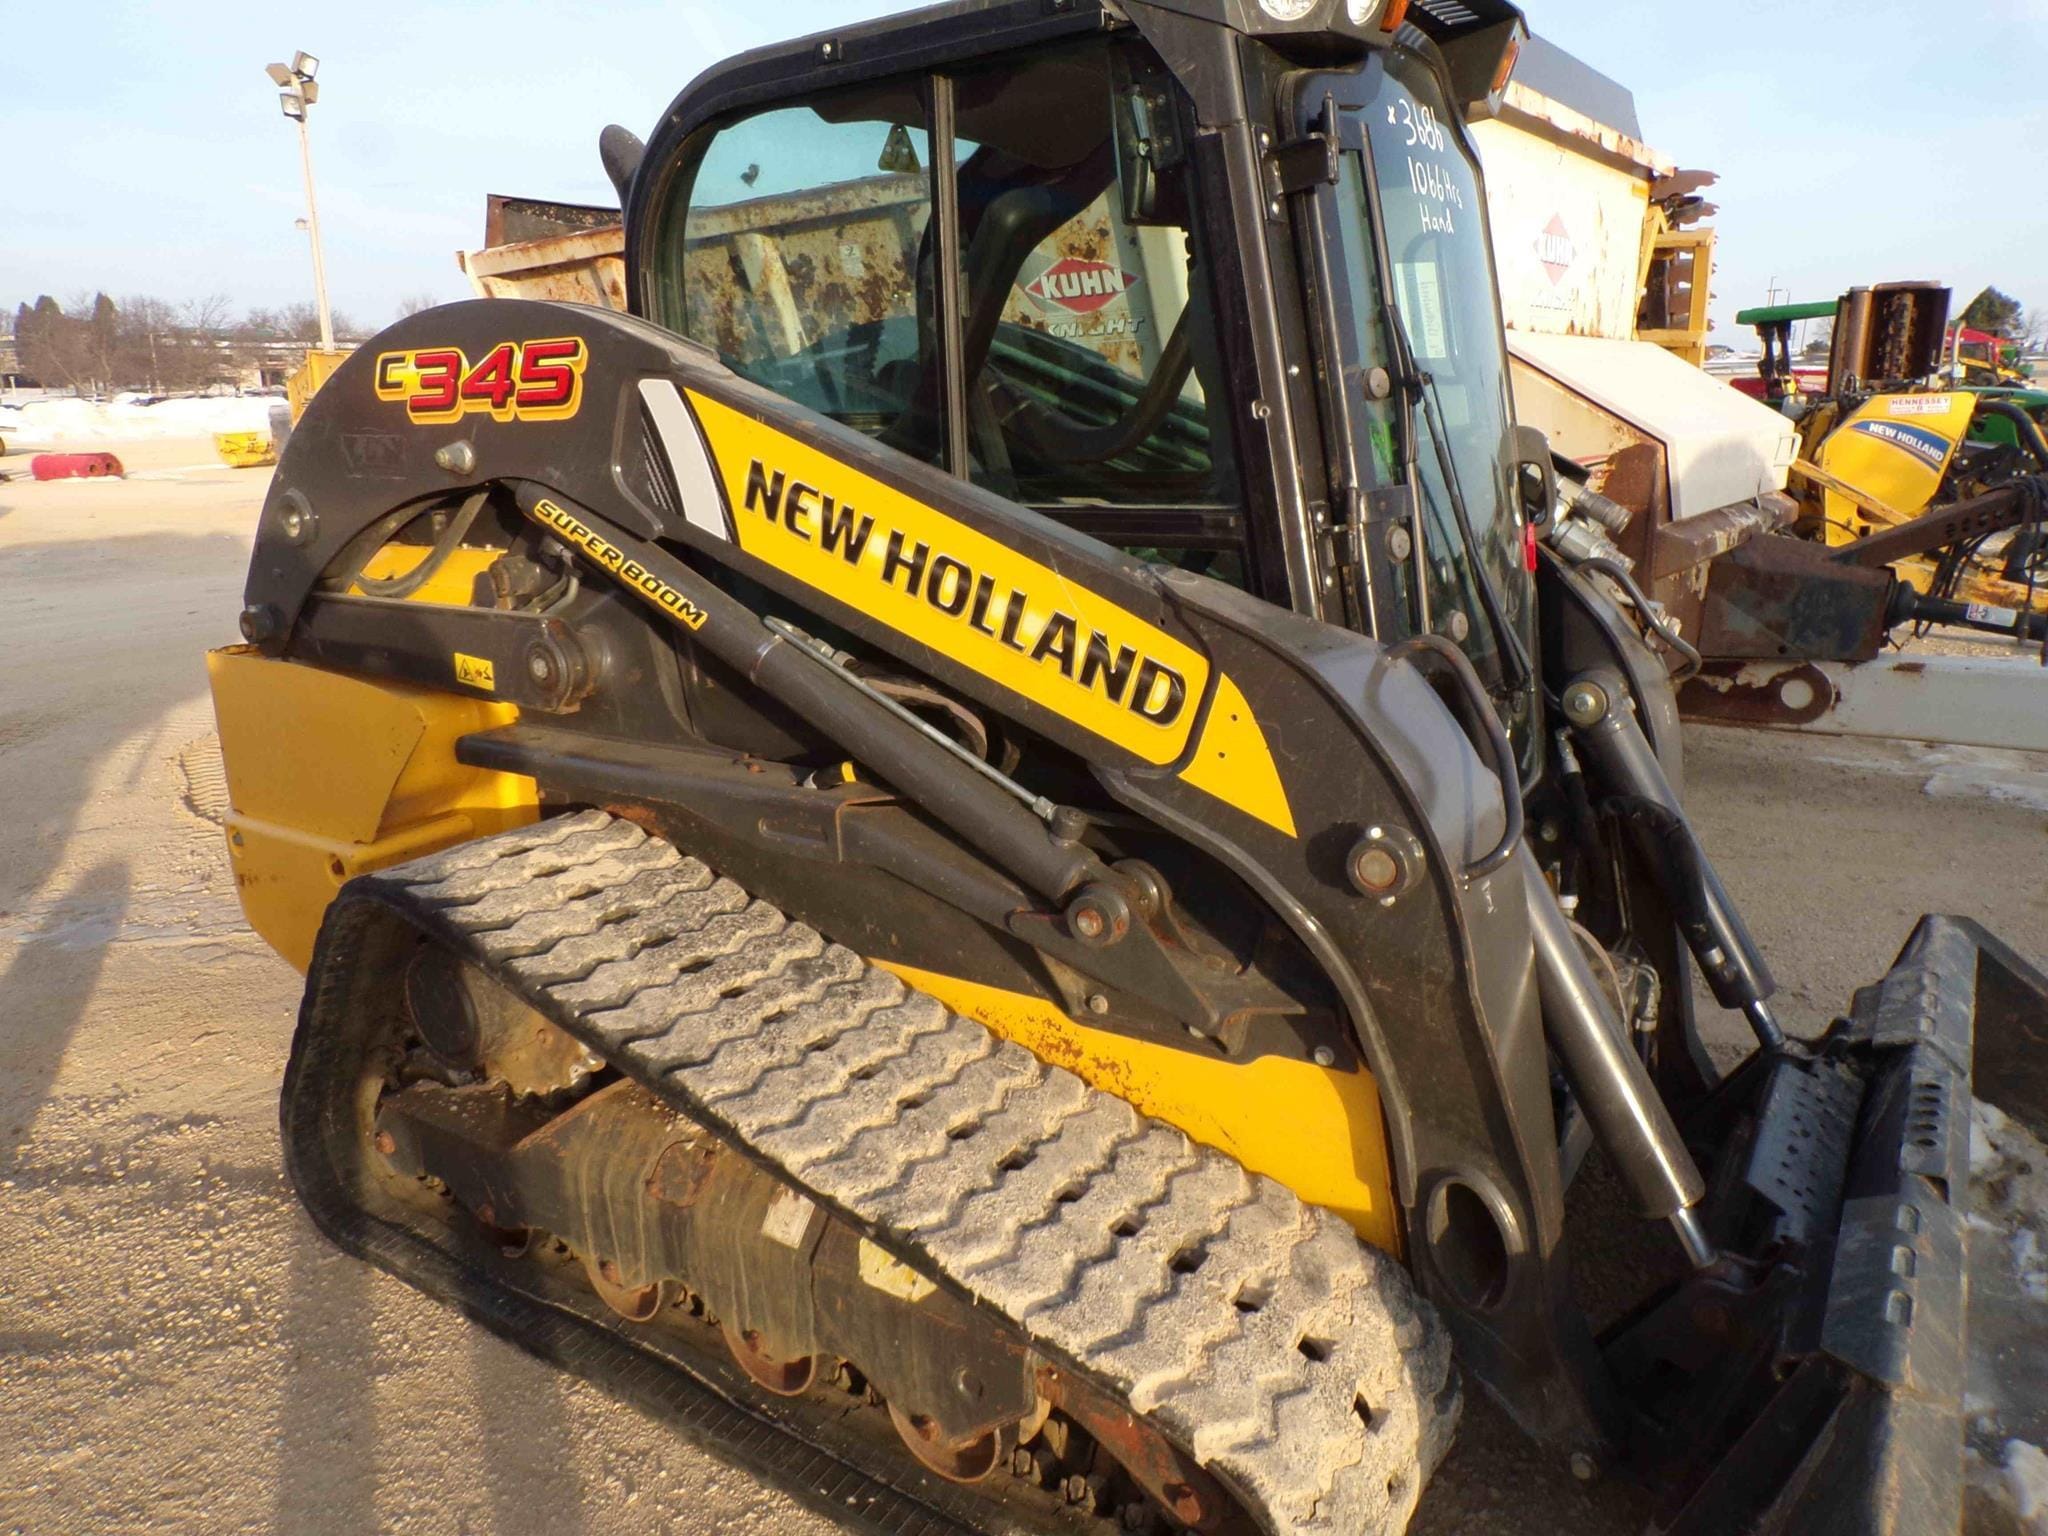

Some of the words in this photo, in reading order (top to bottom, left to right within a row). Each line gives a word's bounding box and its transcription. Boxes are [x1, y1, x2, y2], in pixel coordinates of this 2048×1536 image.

[1419, 202, 1454, 234] Hand
[1040, 268, 1125, 299] KUHN
[375, 338, 587, 421] C345
[1869, 422, 1897, 438] NEW
[1896, 431, 1944, 462] HOLLAND
[744, 458, 875, 567] NEW
[880, 528, 1188, 727] HOLLAND
